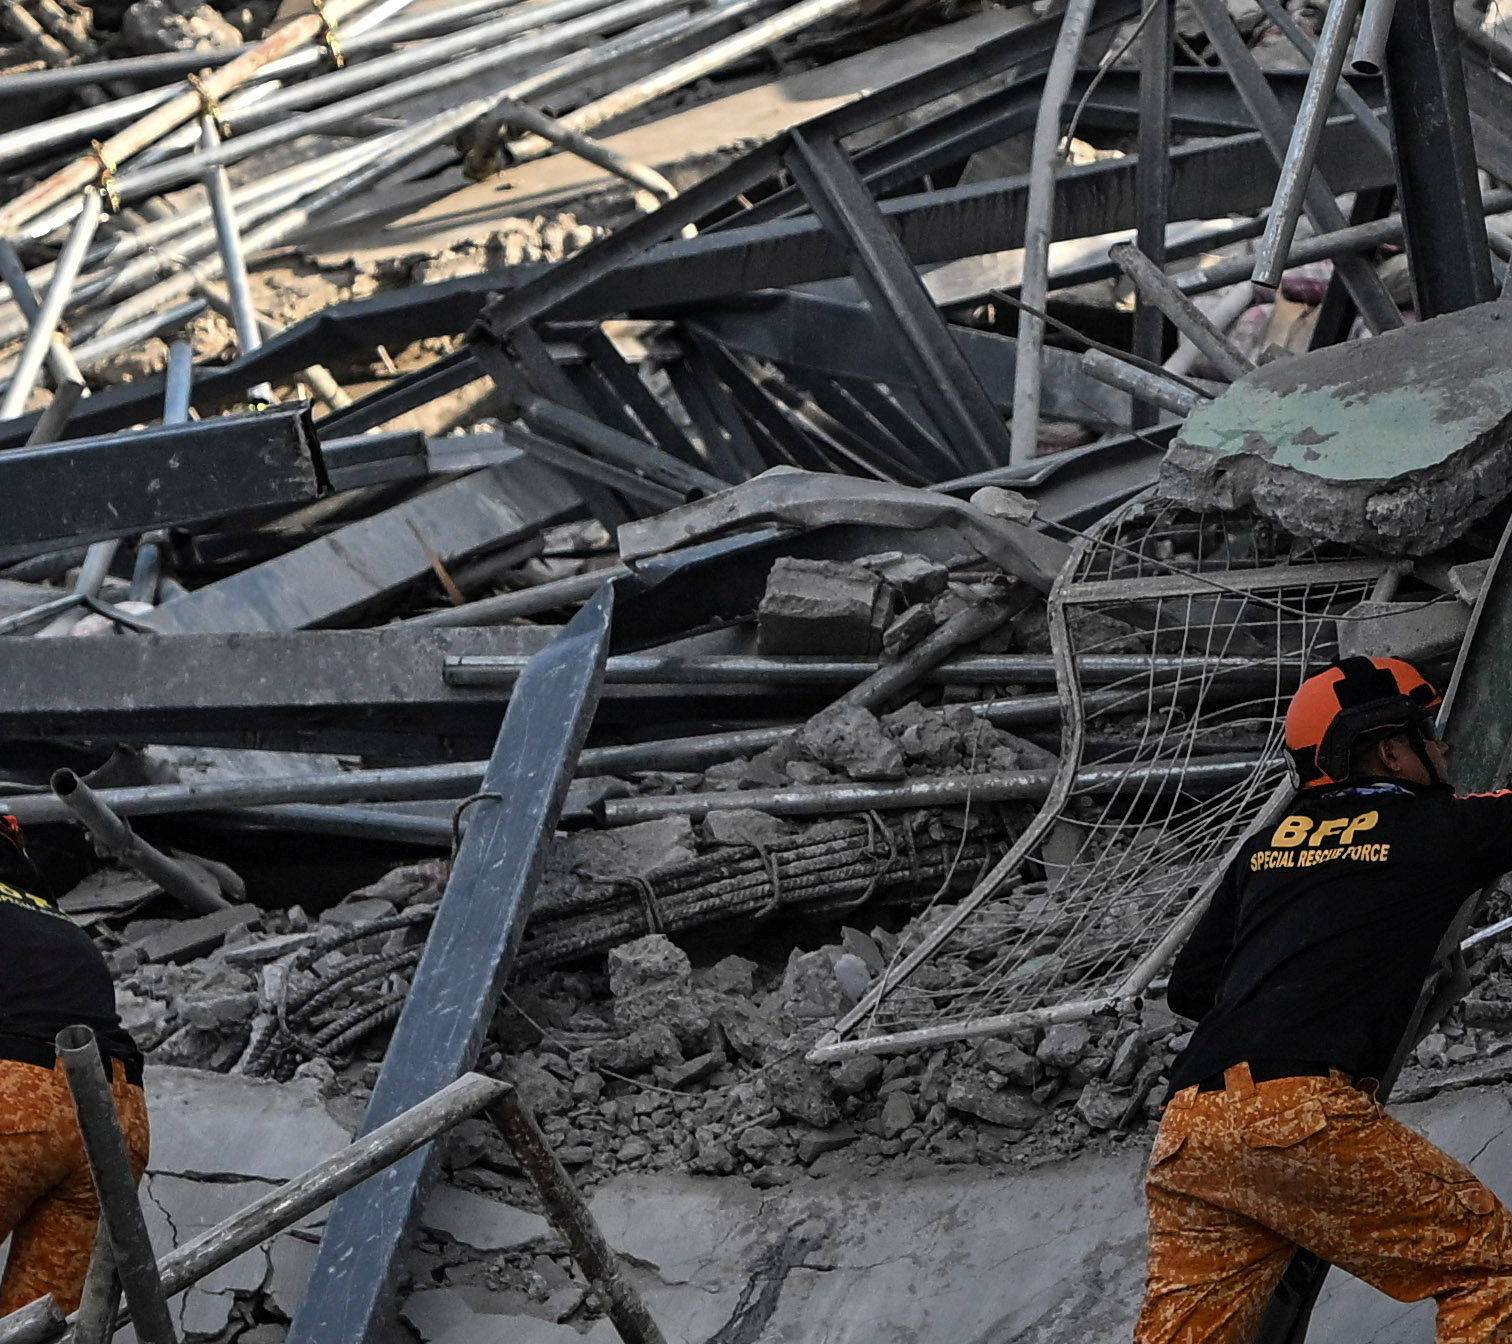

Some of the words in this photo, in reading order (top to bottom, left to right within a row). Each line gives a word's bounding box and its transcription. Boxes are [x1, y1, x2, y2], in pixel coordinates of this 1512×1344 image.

[1271, 810, 1379, 848] BFP
[1250, 849, 1295, 872] SPECIAL
[1297, 846, 1345, 869] RESCUE
[1342, 843, 1391, 863] FORCE
